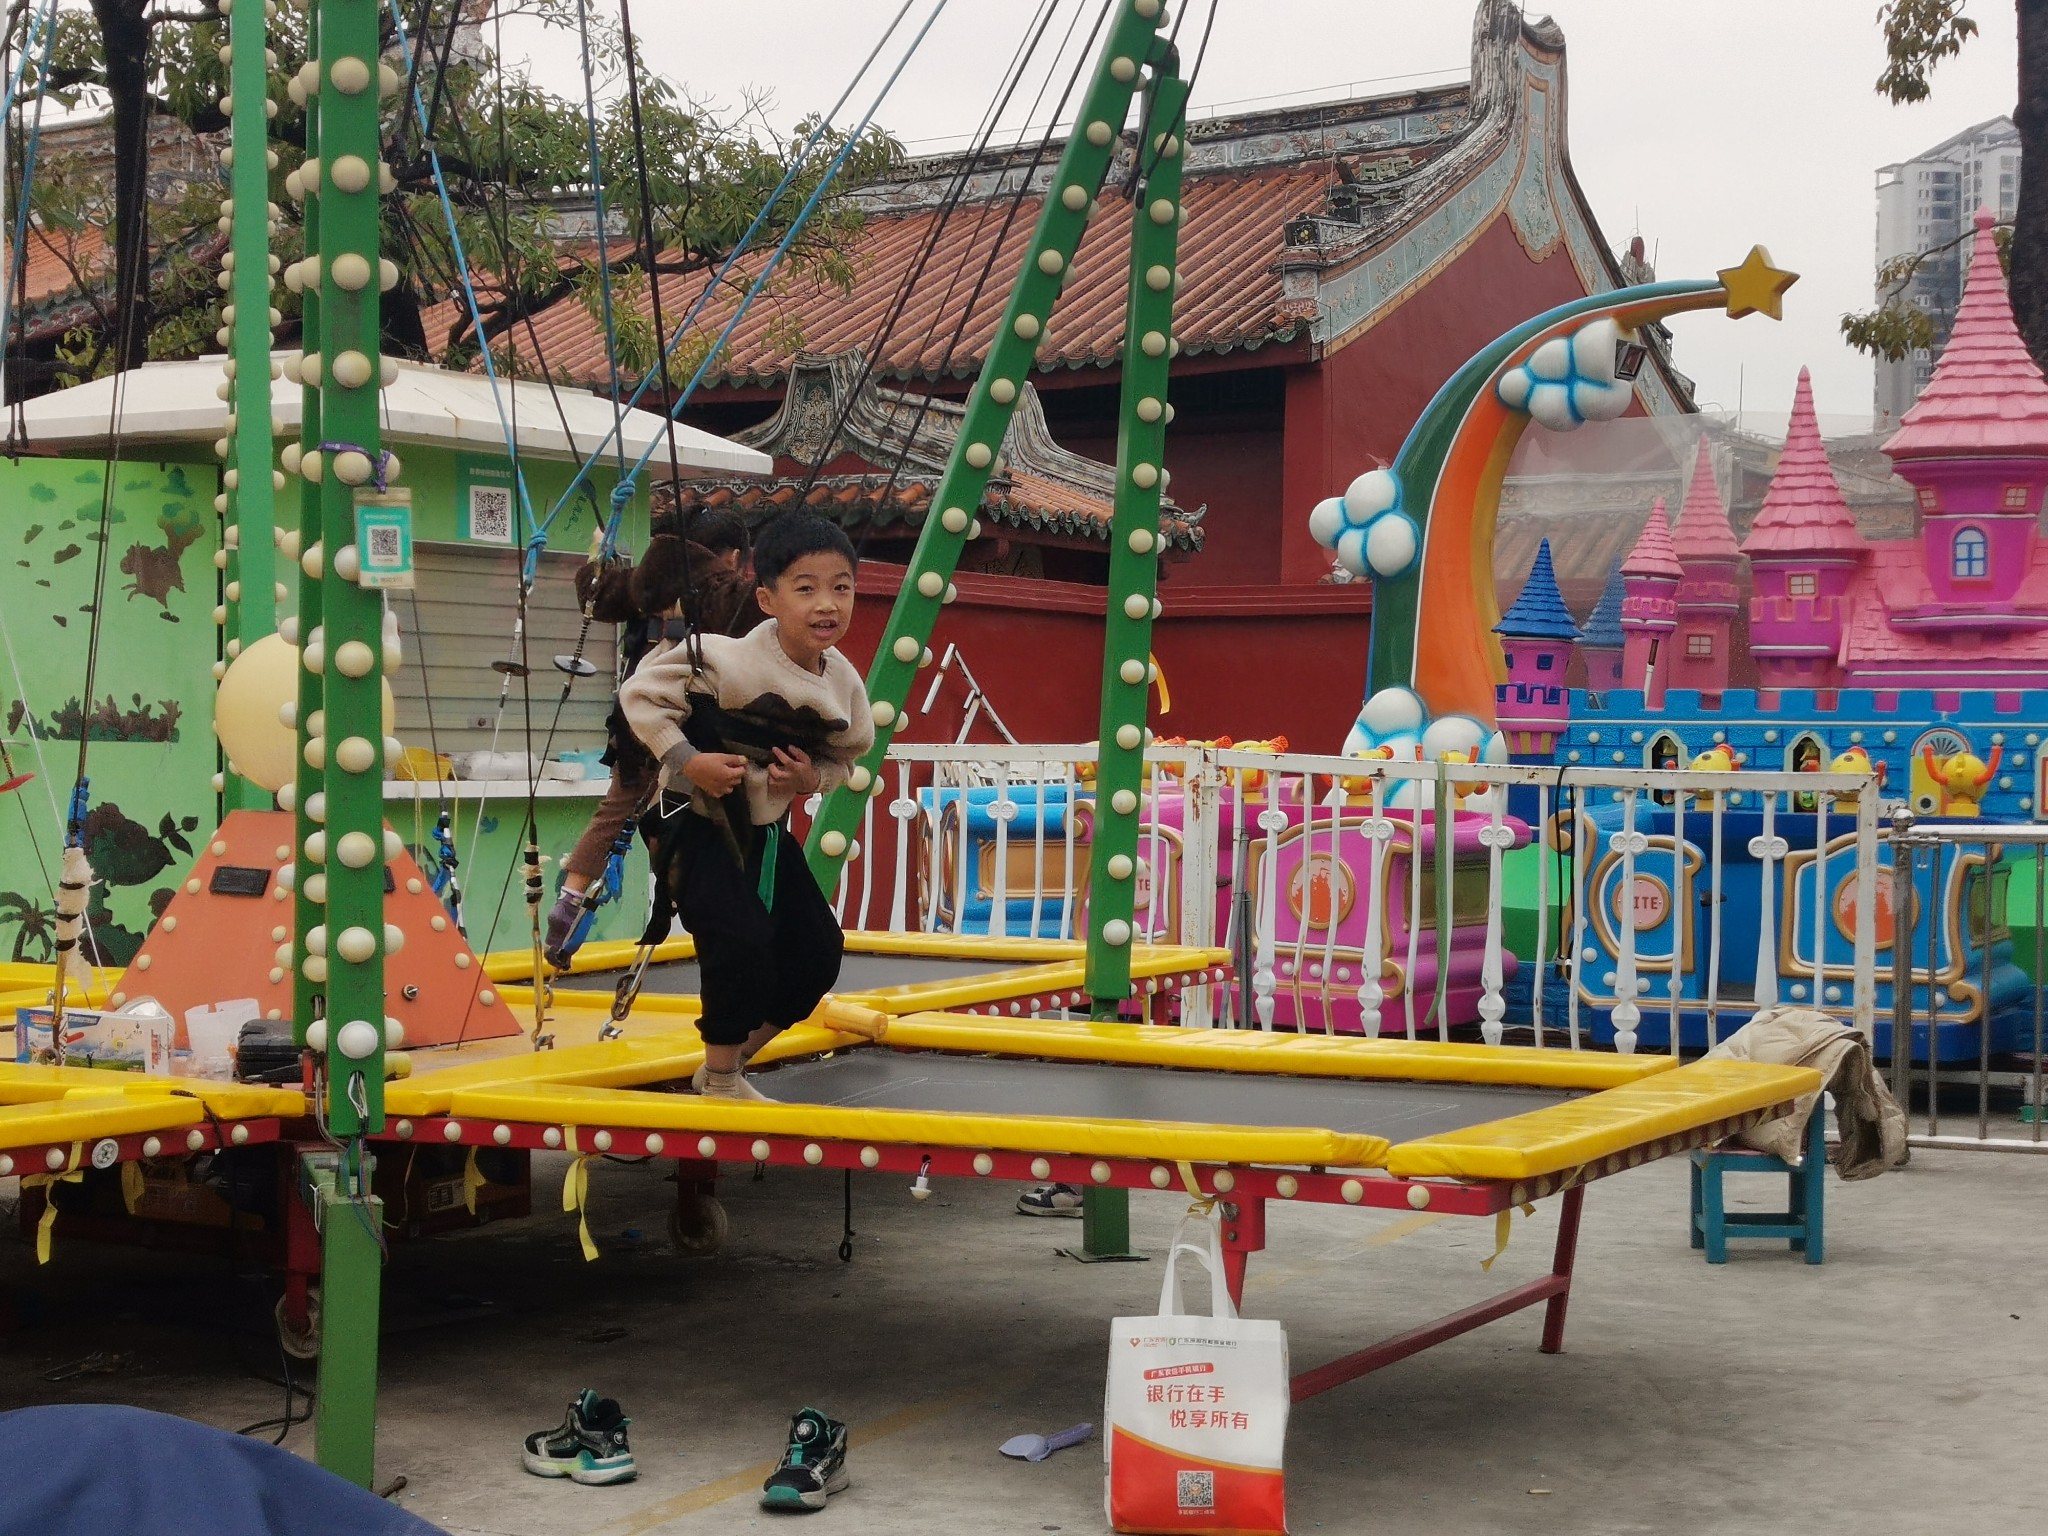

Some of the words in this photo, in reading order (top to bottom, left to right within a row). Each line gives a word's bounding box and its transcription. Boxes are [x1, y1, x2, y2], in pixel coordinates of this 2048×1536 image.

[1634, 896, 1658, 910] ITE
[1146, 1384, 1225, 1403] 银行在手
[1170, 1409, 1249, 1430] 悦享所有
